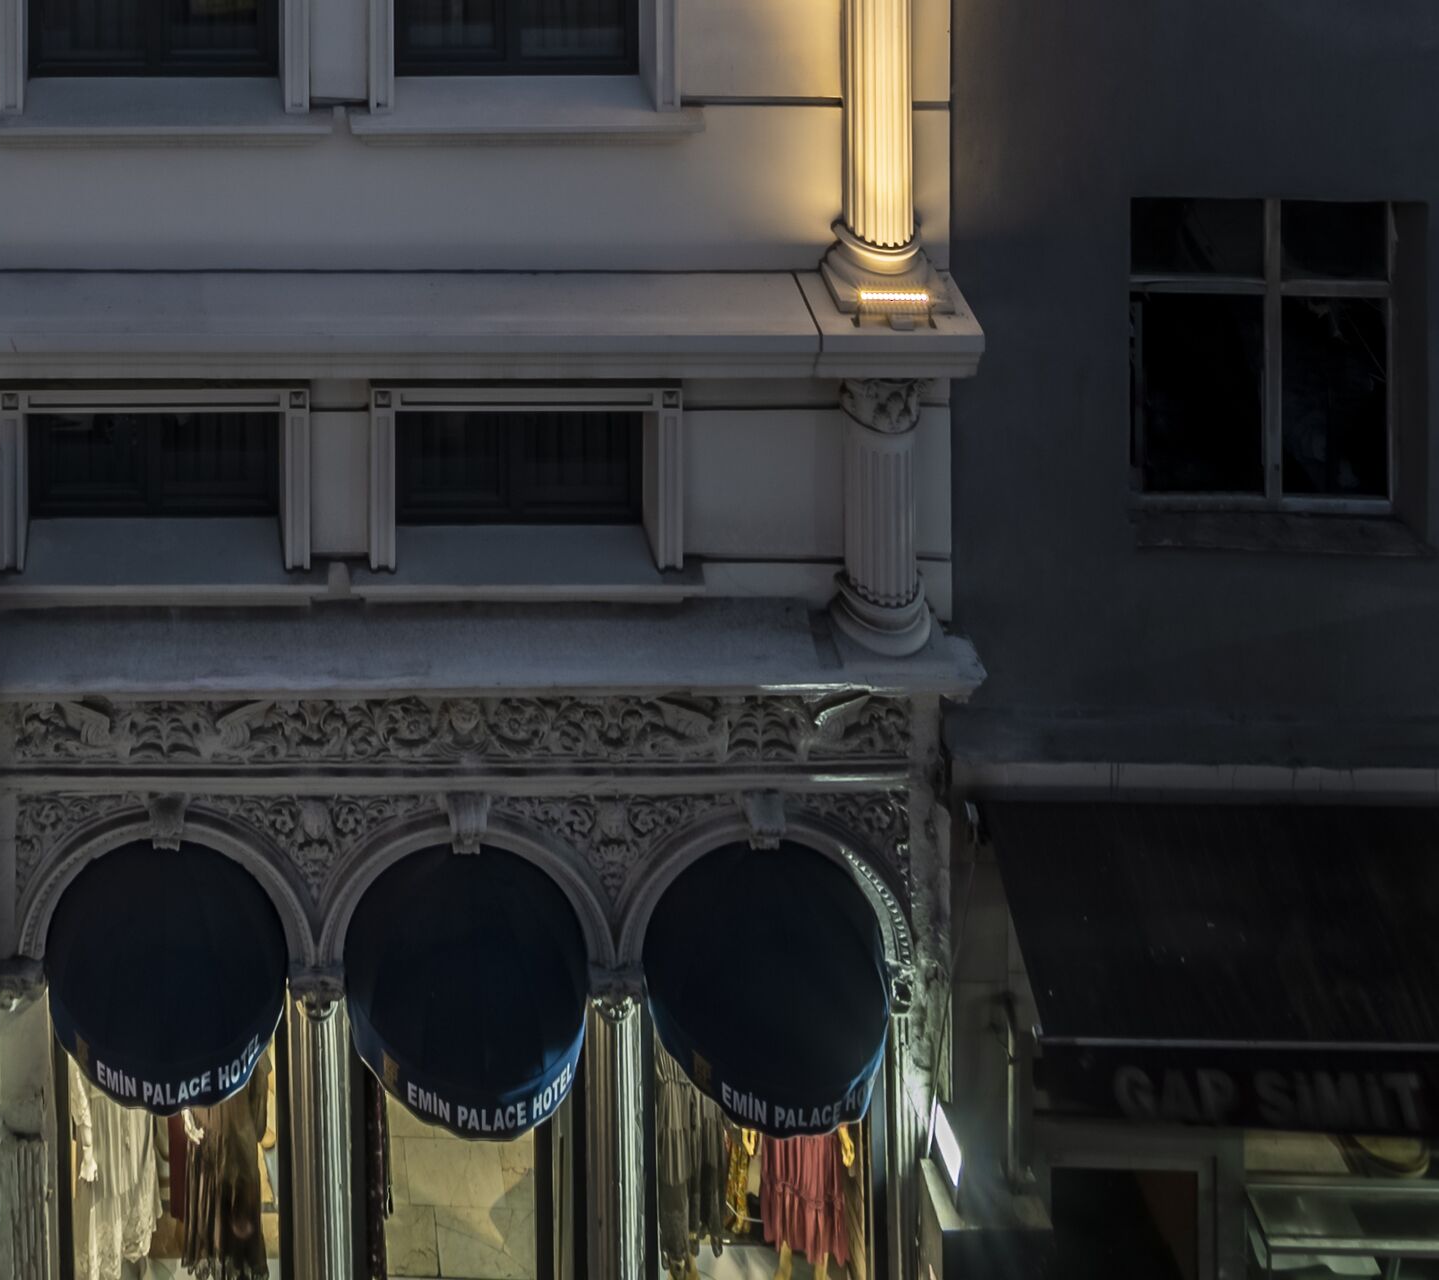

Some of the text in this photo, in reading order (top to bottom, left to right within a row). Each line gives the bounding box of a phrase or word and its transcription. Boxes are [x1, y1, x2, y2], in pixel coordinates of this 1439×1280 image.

[96, 1032, 260, 1106] EMİN PALACE HOTEL
[406, 1062, 572, 1132] EMİN PALACE HOTEL
[1112, 1064, 1239, 1123] GAP
[721, 1080, 767, 1126] EMİN
[774, 1100, 842, 1129] PALACE
